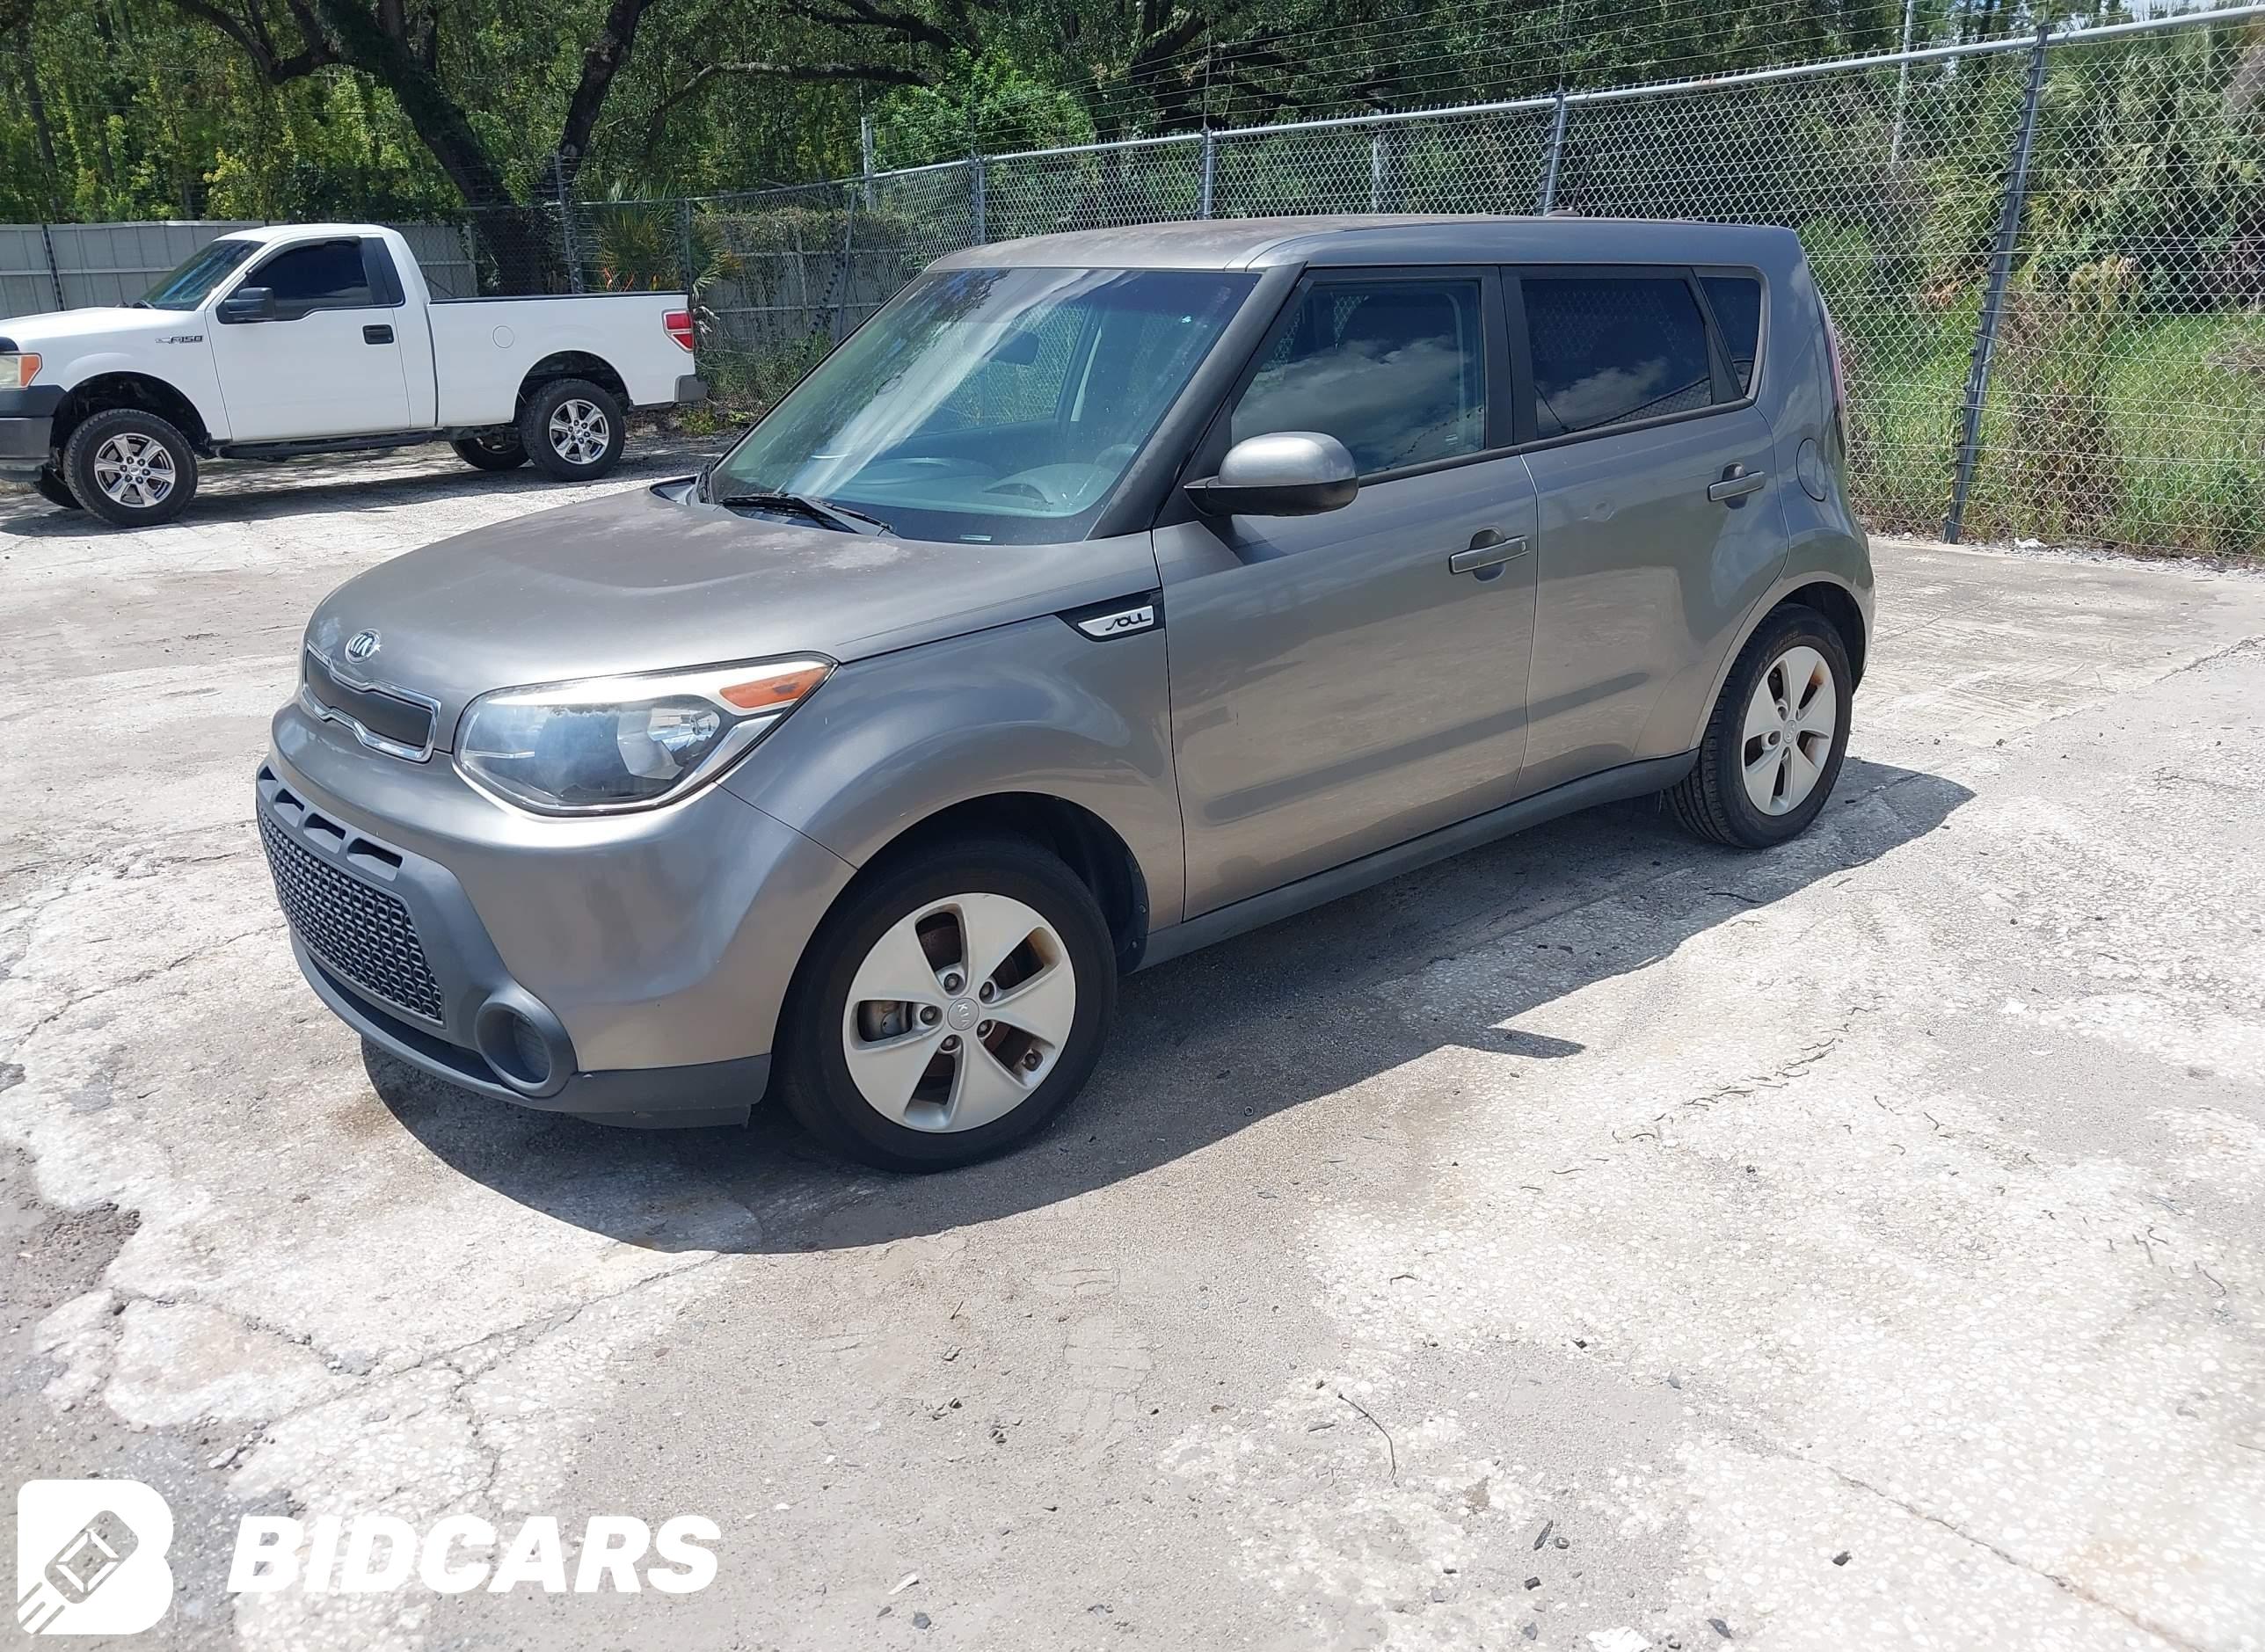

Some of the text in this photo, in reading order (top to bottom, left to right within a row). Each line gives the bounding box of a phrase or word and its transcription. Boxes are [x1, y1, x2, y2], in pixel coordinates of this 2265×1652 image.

[1105, 613, 1152, 631] SOUL
[350, 634, 373, 657] KIA
[958, 1003, 970, 1027] KIA
